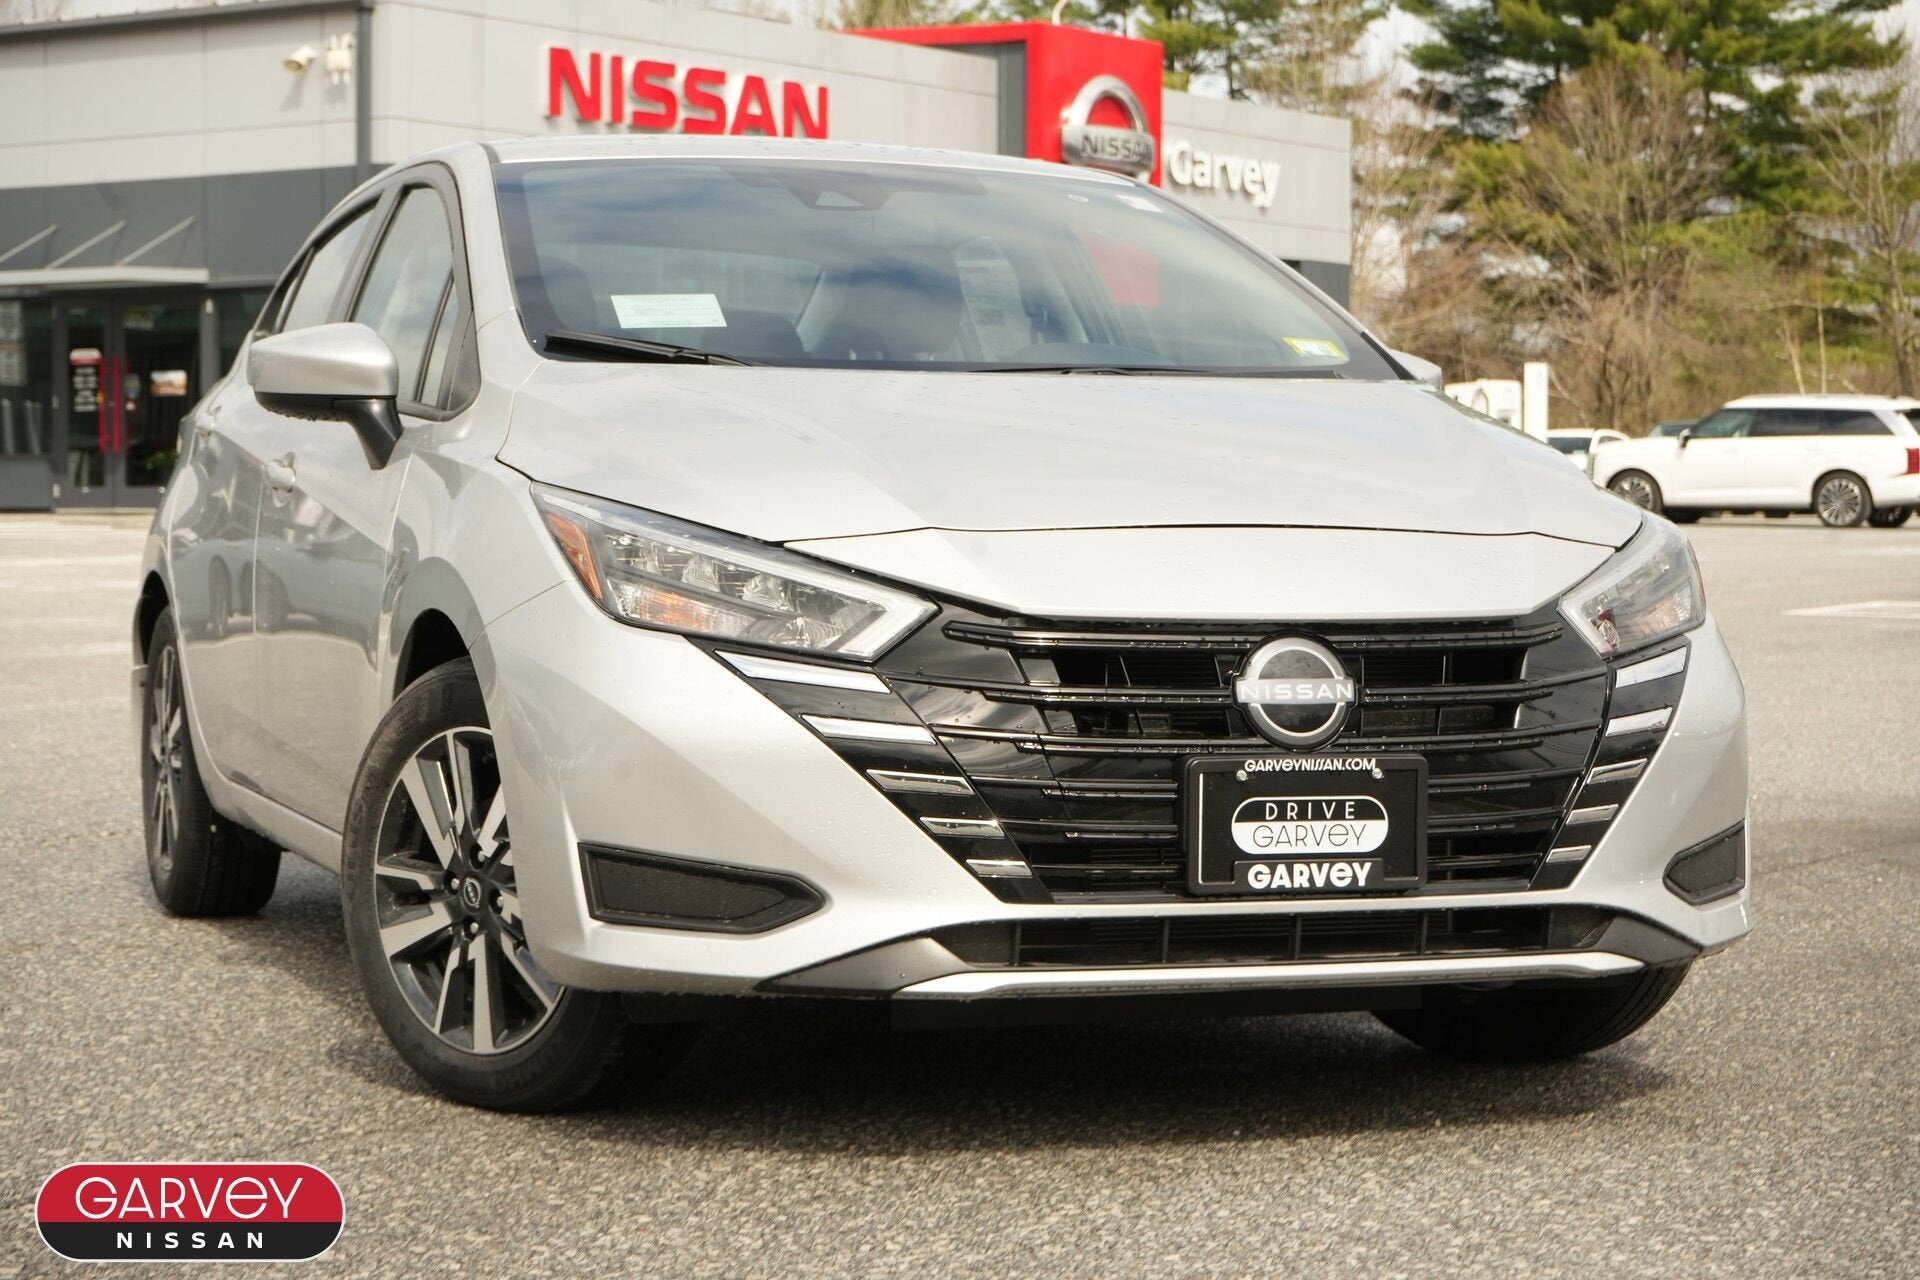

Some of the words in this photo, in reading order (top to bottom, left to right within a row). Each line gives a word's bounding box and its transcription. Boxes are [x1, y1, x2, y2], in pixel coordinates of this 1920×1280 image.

[548, 47, 829, 139] NISSAN
[1169, 140, 1281, 208] Garvey
[1240, 683, 1353, 700] NISSAN
[1265, 801, 1356, 820] DRIVE
